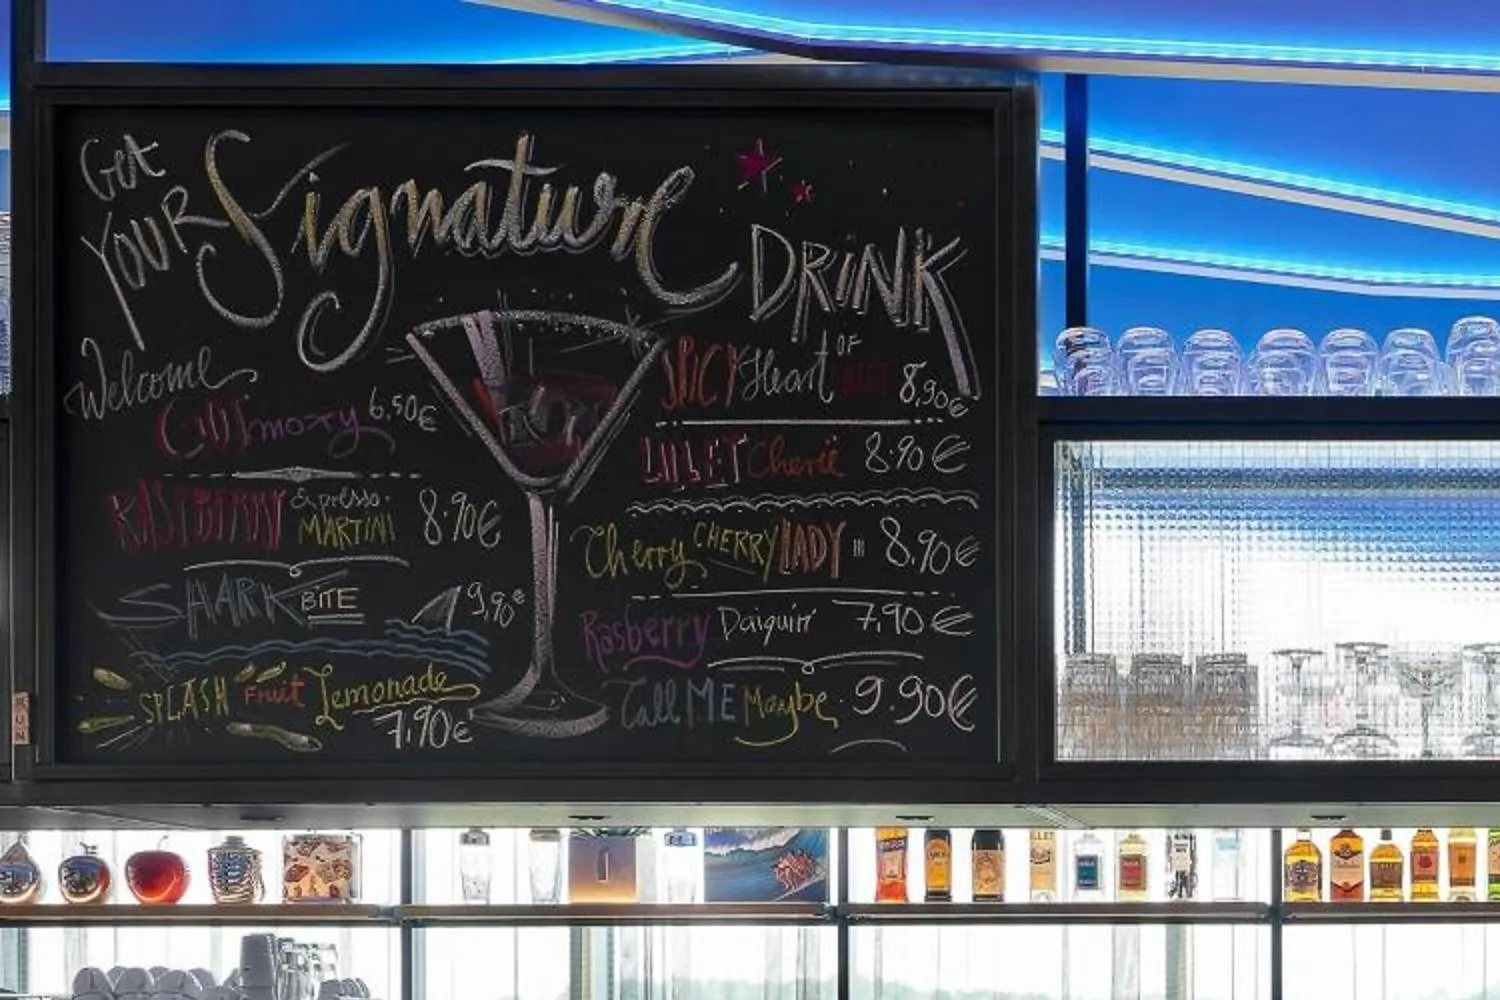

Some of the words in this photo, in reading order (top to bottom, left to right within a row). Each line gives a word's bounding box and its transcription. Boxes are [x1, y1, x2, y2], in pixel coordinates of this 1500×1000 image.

[81, 185, 229, 351] YOUR
[196, 129, 740, 371] Signature
[64, 337, 257, 420] Welcome
[737, 330, 835, 403] Heart
[837, 333, 863, 356] OF
[298, 510, 398, 549] MARTINI
[570, 523, 707, 589] Cherry
[693, 522, 780, 583] CHERRY
[778, 520, 846, 579] LADY
[97, 569, 349, 641] SHARK
[301, 584, 361, 611] BITE
[717, 603, 819, 646] Daiquiri
[140, 677, 230, 726] SPLASH
[243, 677, 305, 708] Fruit
[303, 663, 482, 731] Lemonade
[686, 677, 738, 723] ME
[734, 681, 839, 747] Maybe
